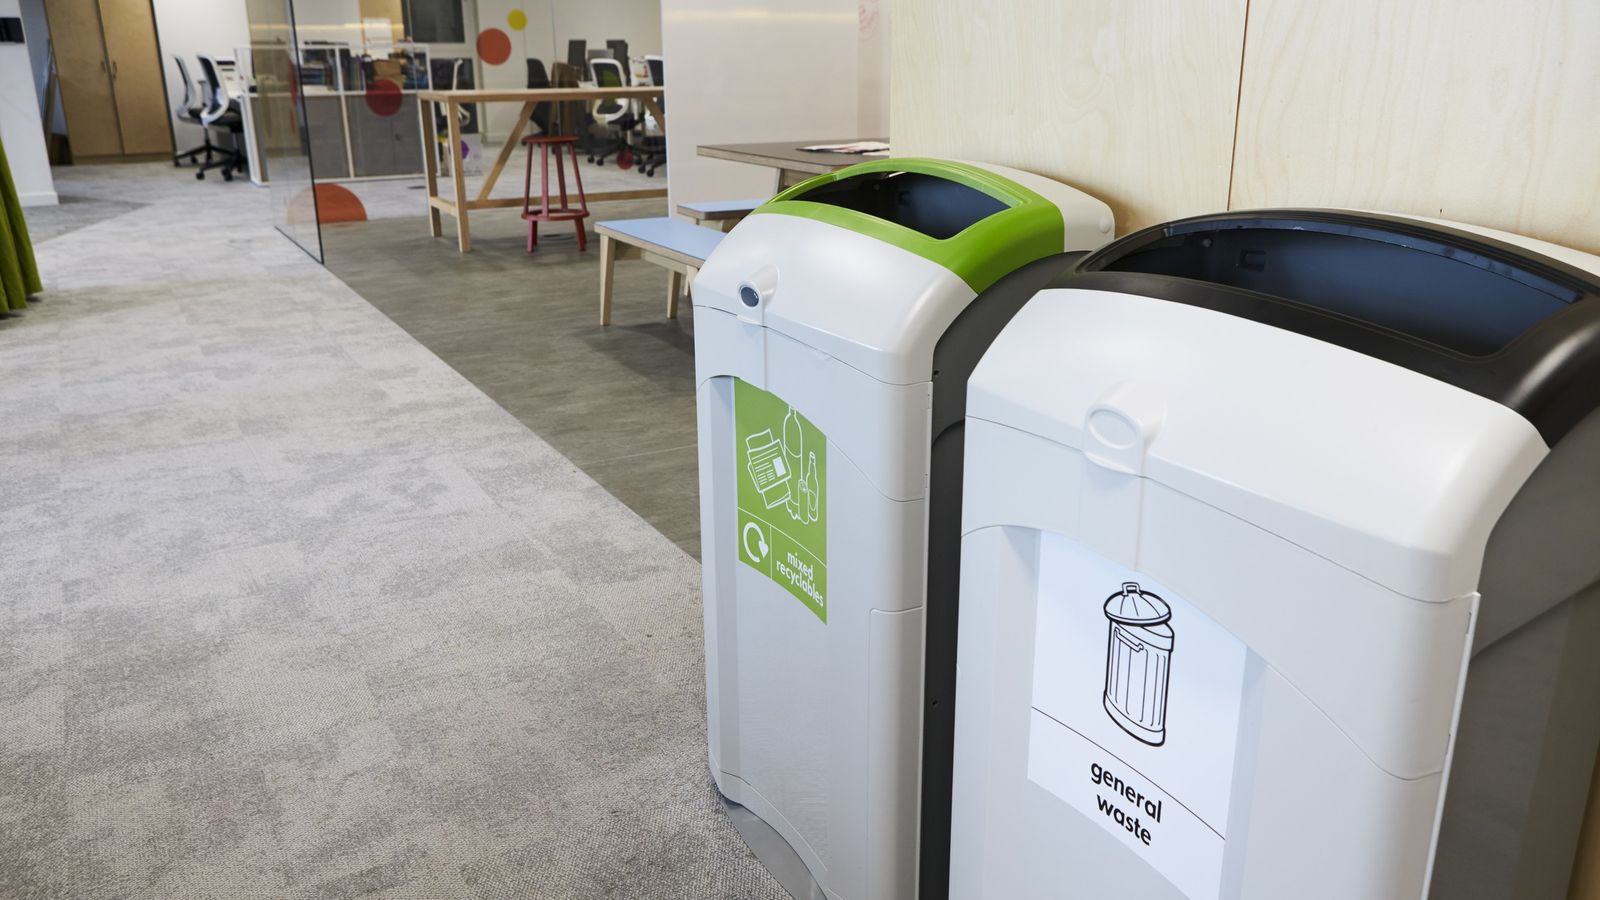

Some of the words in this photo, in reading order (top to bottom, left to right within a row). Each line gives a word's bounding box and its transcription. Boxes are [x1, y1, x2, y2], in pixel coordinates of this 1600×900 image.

[776, 560, 824, 608] recyclables
[787, 552, 813, 581] mixed
[1091, 763, 1161, 823] general
[1096, 793, 1152, 846] waste
